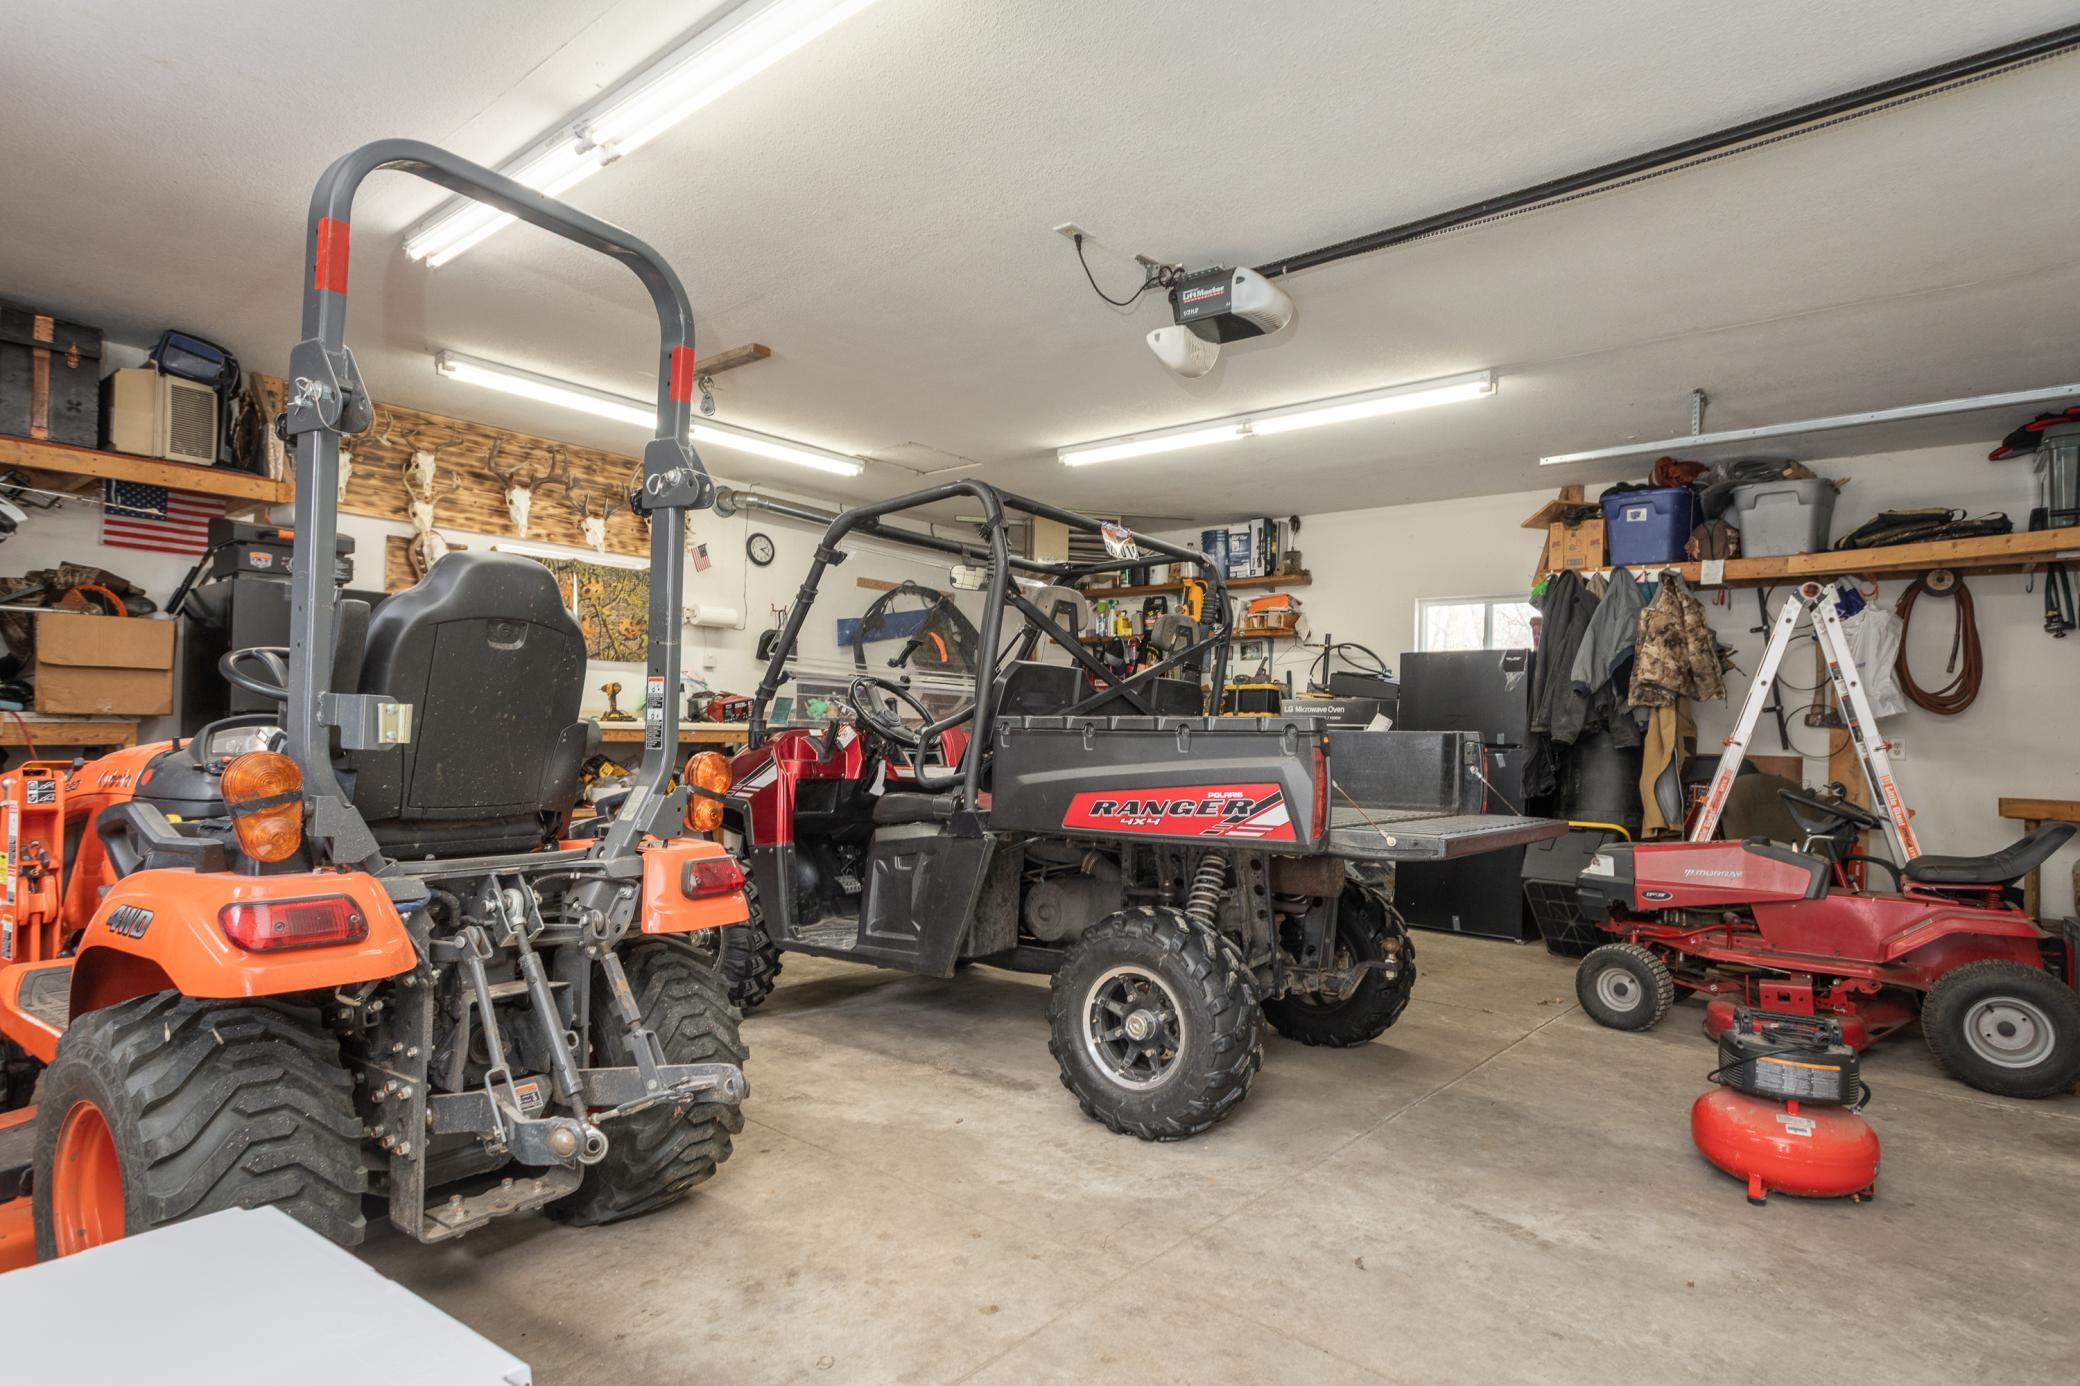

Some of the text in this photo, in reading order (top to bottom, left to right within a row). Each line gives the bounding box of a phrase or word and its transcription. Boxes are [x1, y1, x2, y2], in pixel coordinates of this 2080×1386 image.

[1183, 286, 1225, 300] LiftMaster
[1284, 705, 1345, 713] LG Microwave Oven
[1088, 799, 1257, 818] RANGER
[106, 904, 155, 940] 4WD
